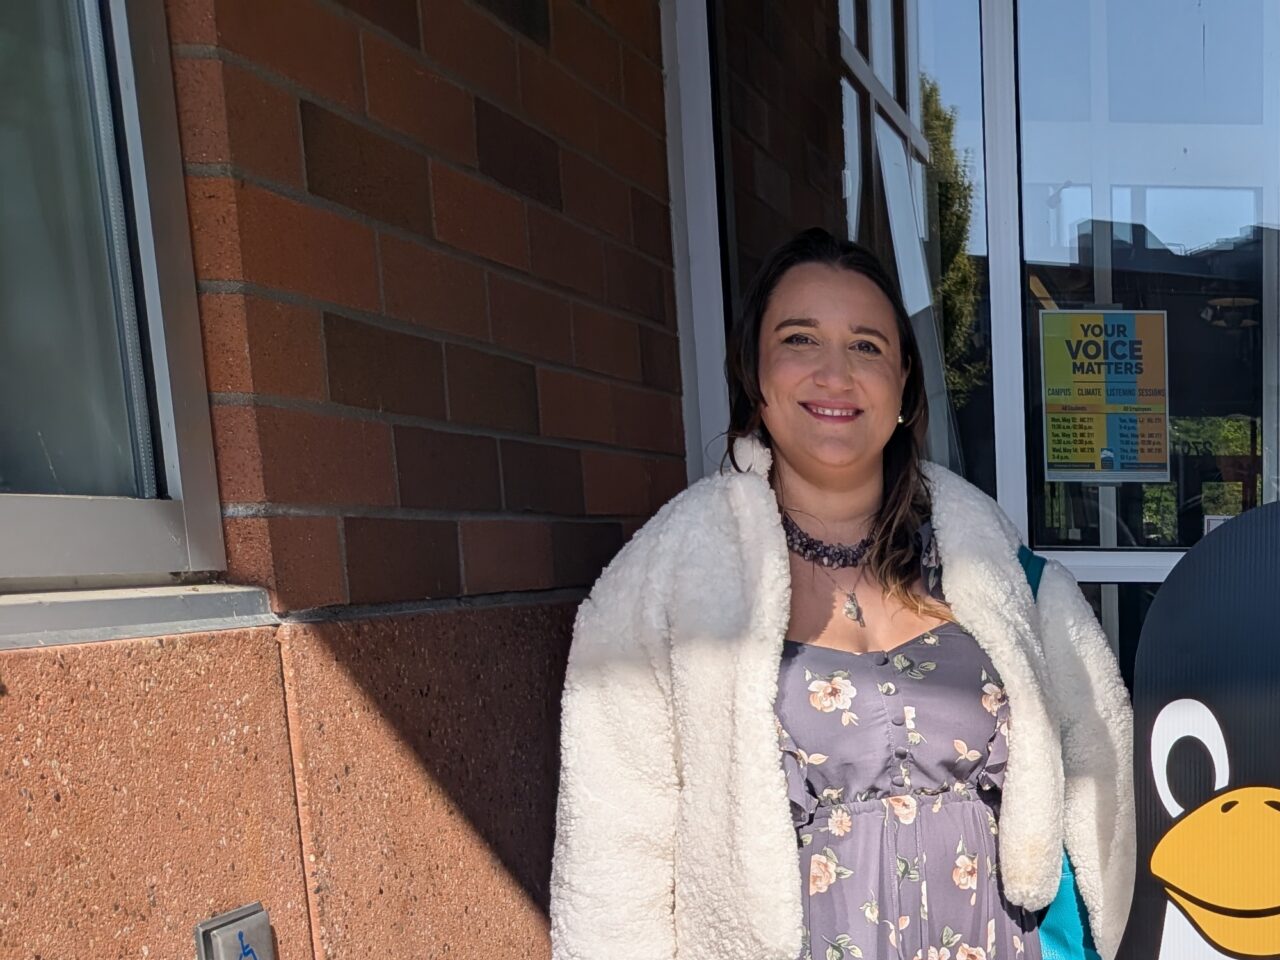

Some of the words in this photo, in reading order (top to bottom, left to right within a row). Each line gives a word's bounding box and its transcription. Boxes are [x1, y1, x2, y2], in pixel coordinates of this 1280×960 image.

[1080, 324, 1127, 337] YOUR
[1065, 340, 1143, 360] VOICE
[1072, 362, 1144, 375] MATTERS
[1048, 388, 1071, 397] CAMPUS
[1078, 388, 1102, 397] CLIMATE
[1107, 388, 1136, 397] LISTENING
[1138, 388, 1165, 397] SESSIONS
